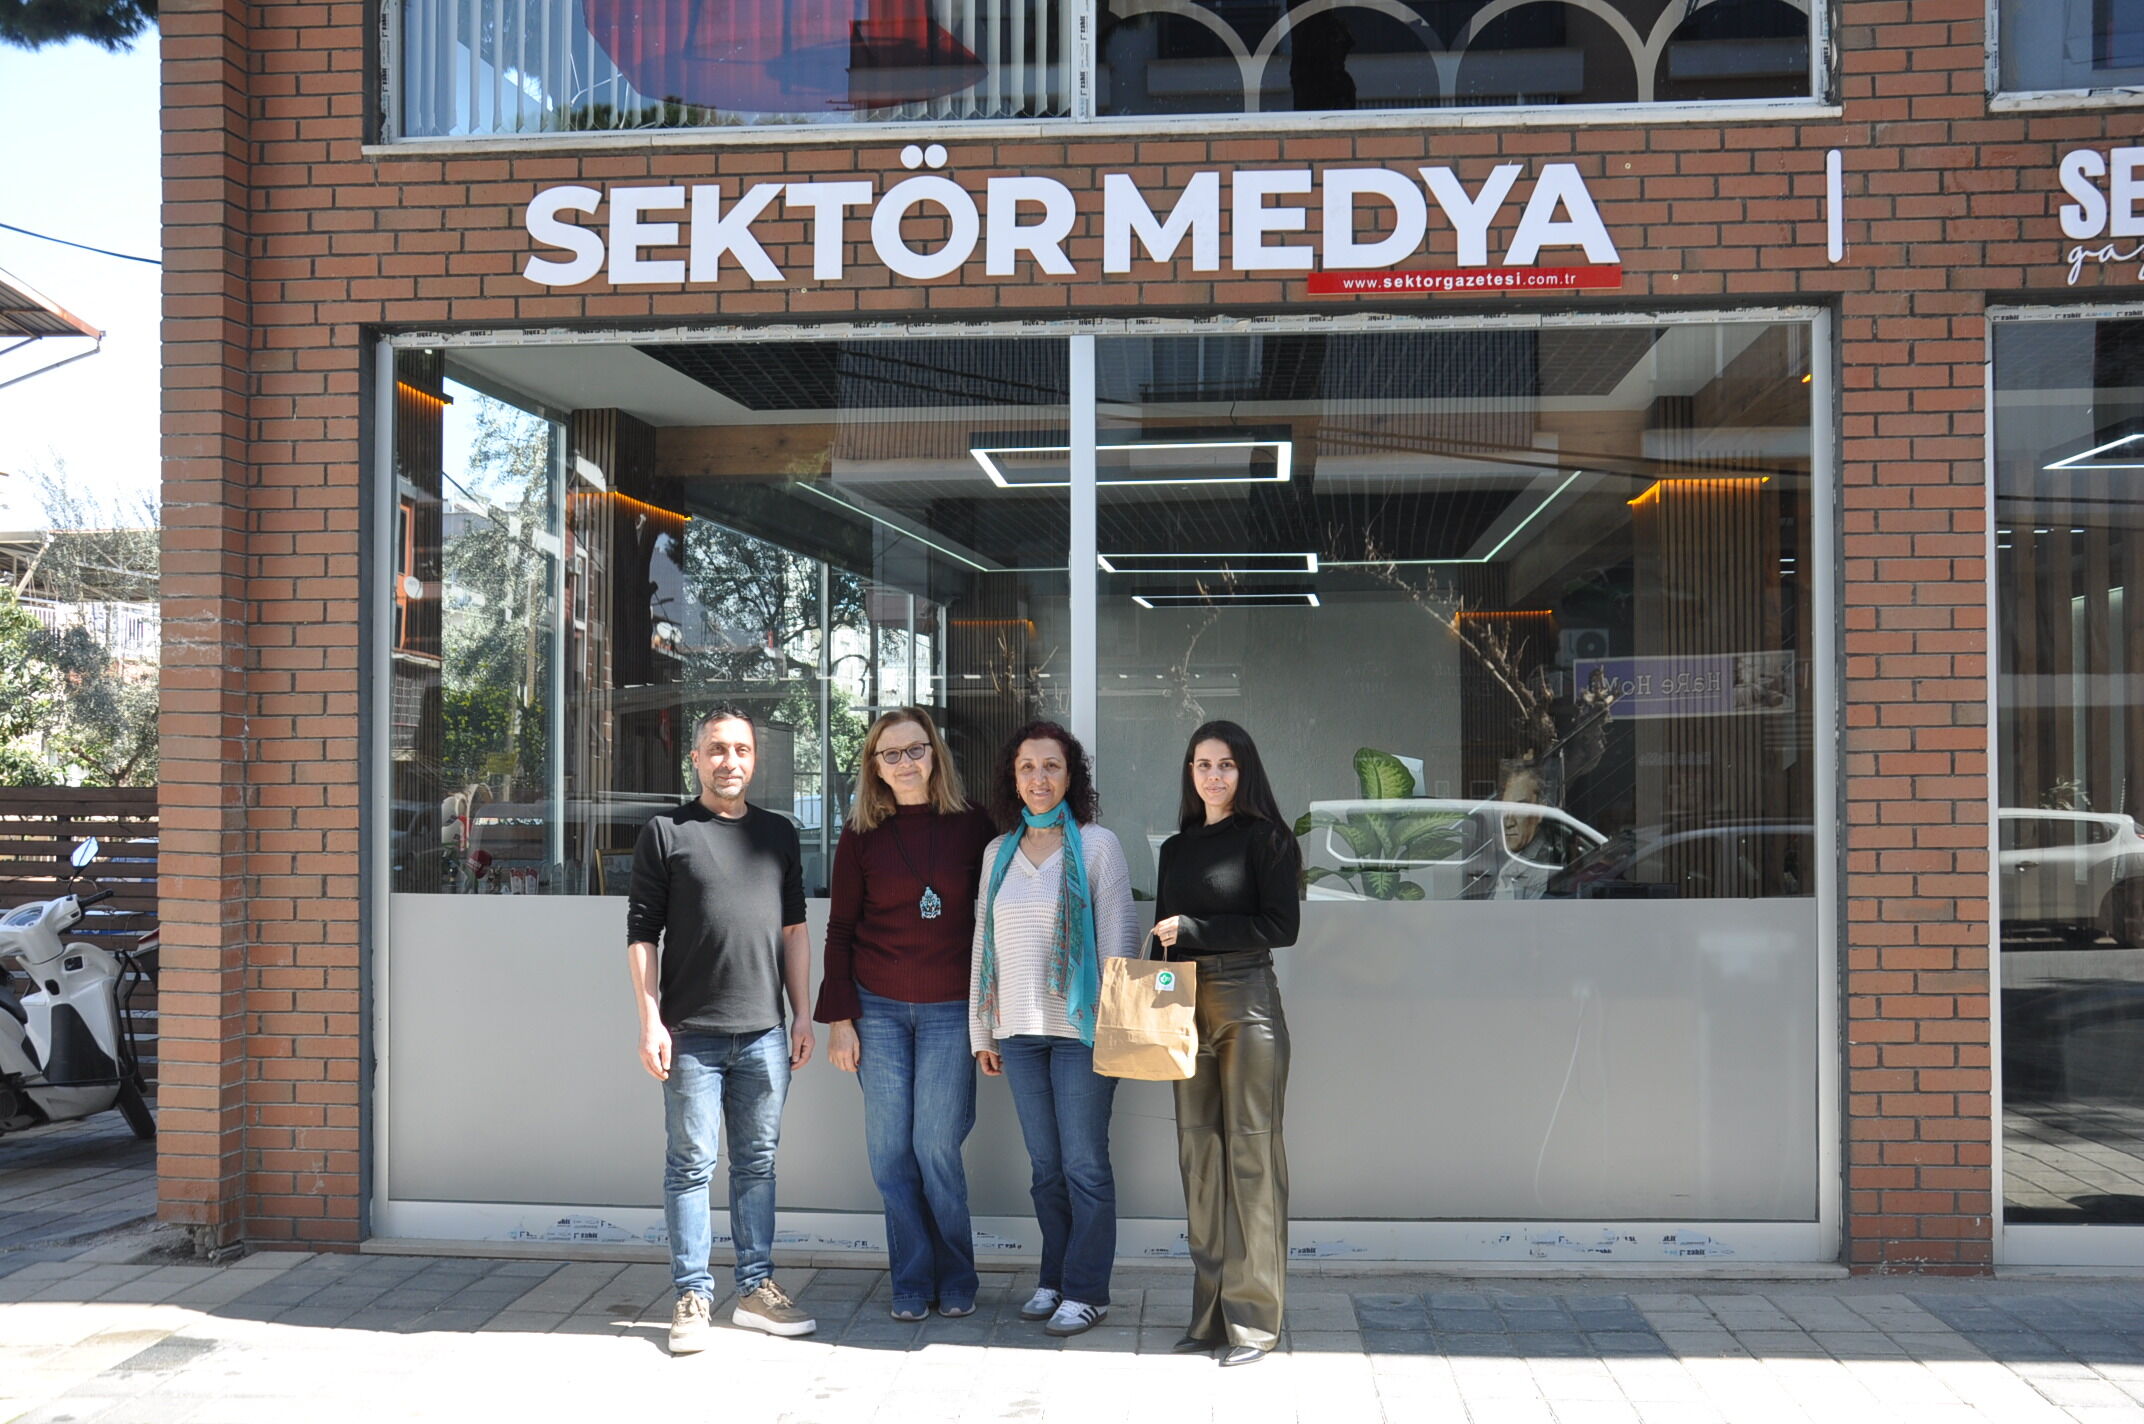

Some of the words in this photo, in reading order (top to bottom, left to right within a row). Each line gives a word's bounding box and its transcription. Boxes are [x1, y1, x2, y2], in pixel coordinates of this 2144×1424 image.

[523, 144, 1077, 286] SEKTÖR
[1103, 161, 1621, 273] MEDYA
[1342, 272, 1577, 290] www.sektorgazetesi.com.tr
